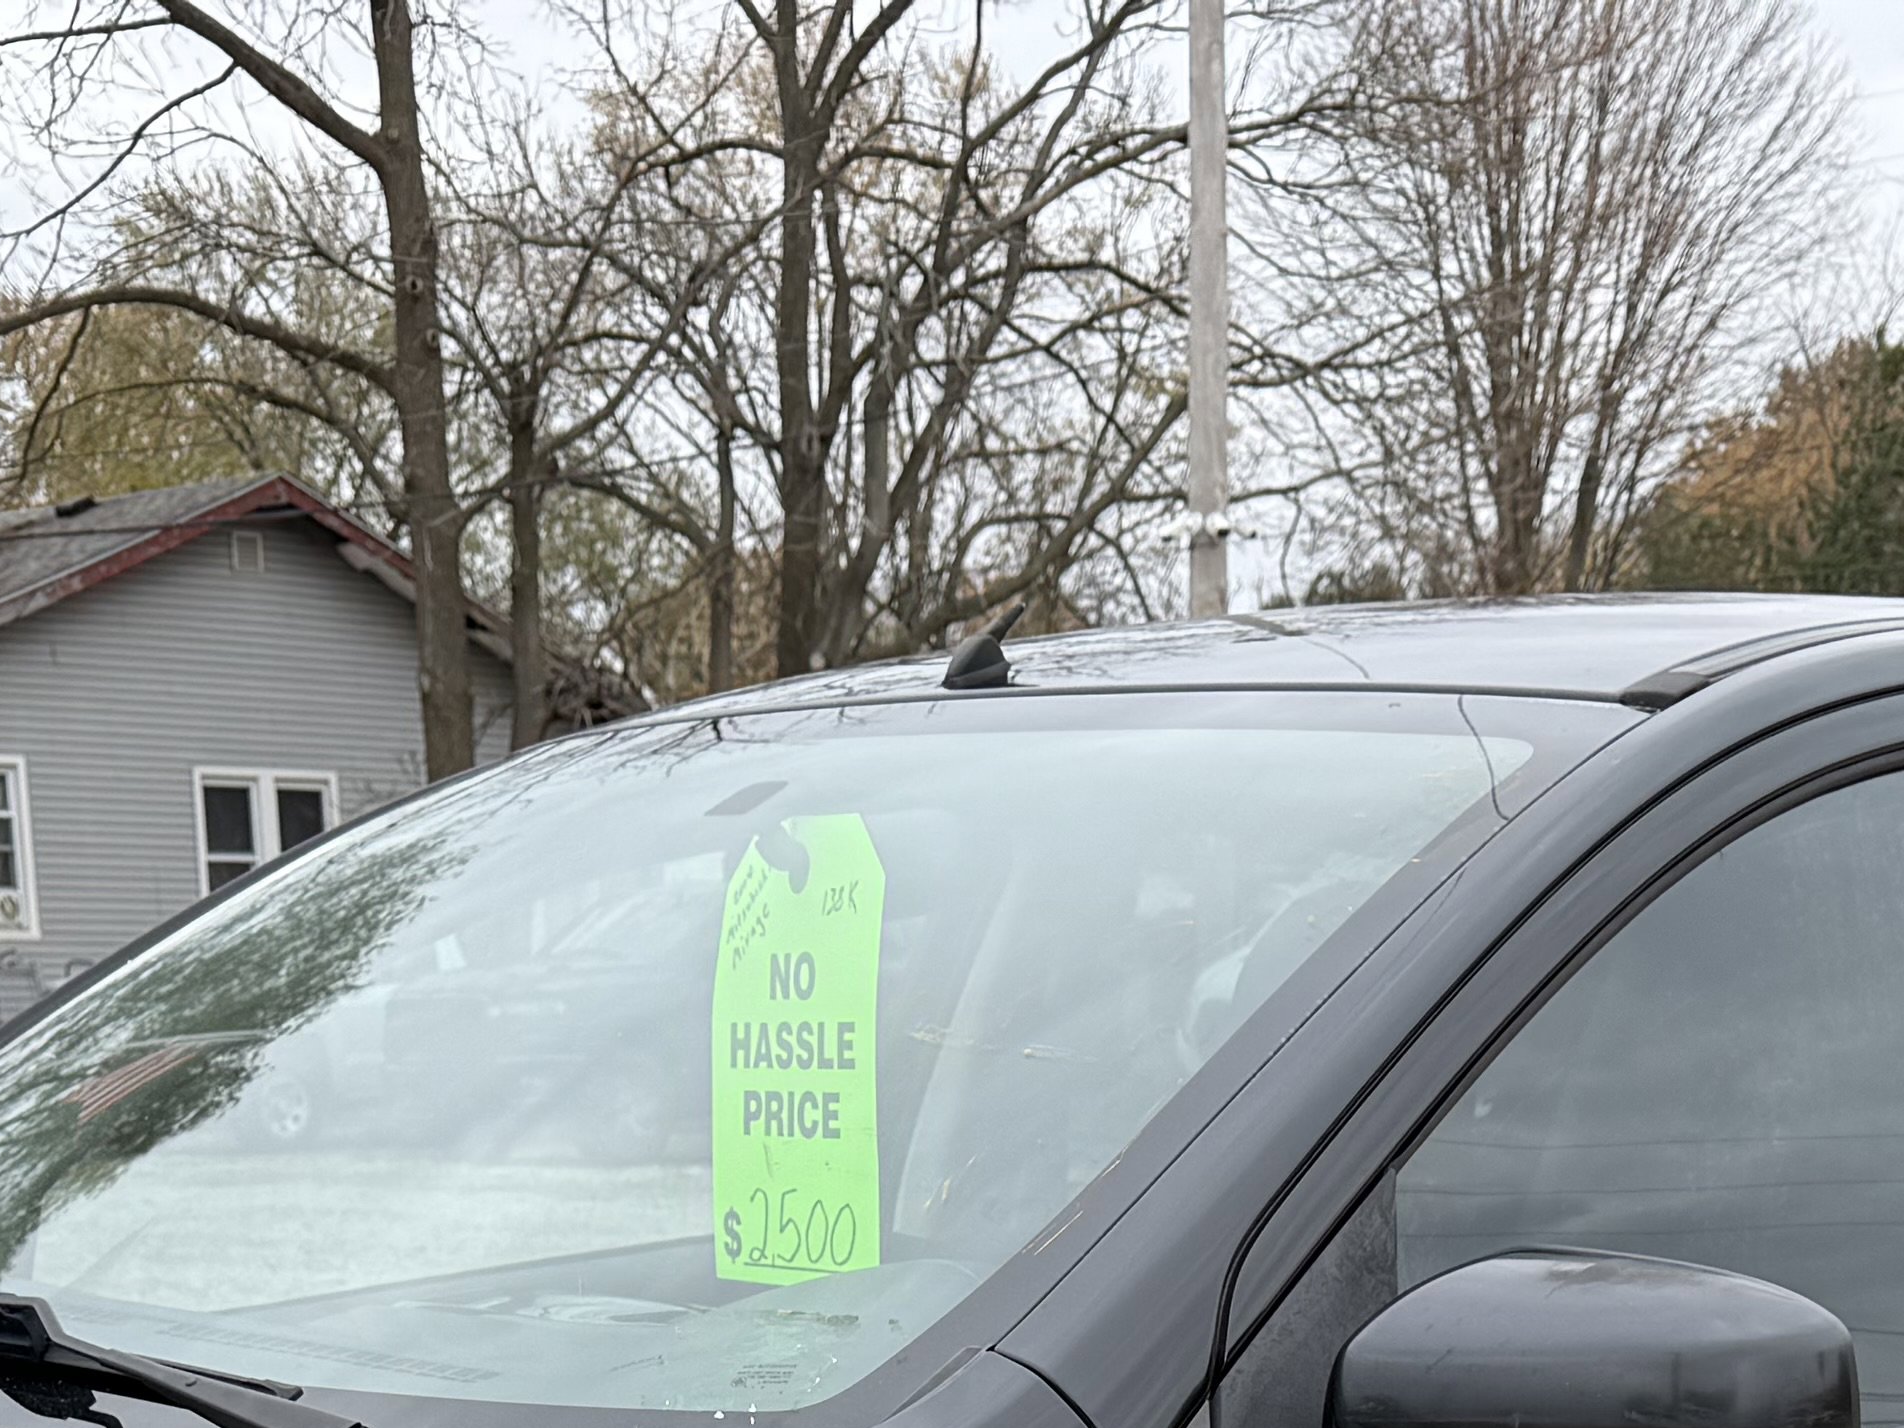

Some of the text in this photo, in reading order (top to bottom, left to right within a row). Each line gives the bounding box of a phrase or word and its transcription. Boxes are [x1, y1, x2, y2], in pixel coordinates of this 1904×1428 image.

[769, 951, 816, 1001] NO
[730, 1021, 856, 1071] HASSLE
[743, 1090, 841, 1140] PRICE
